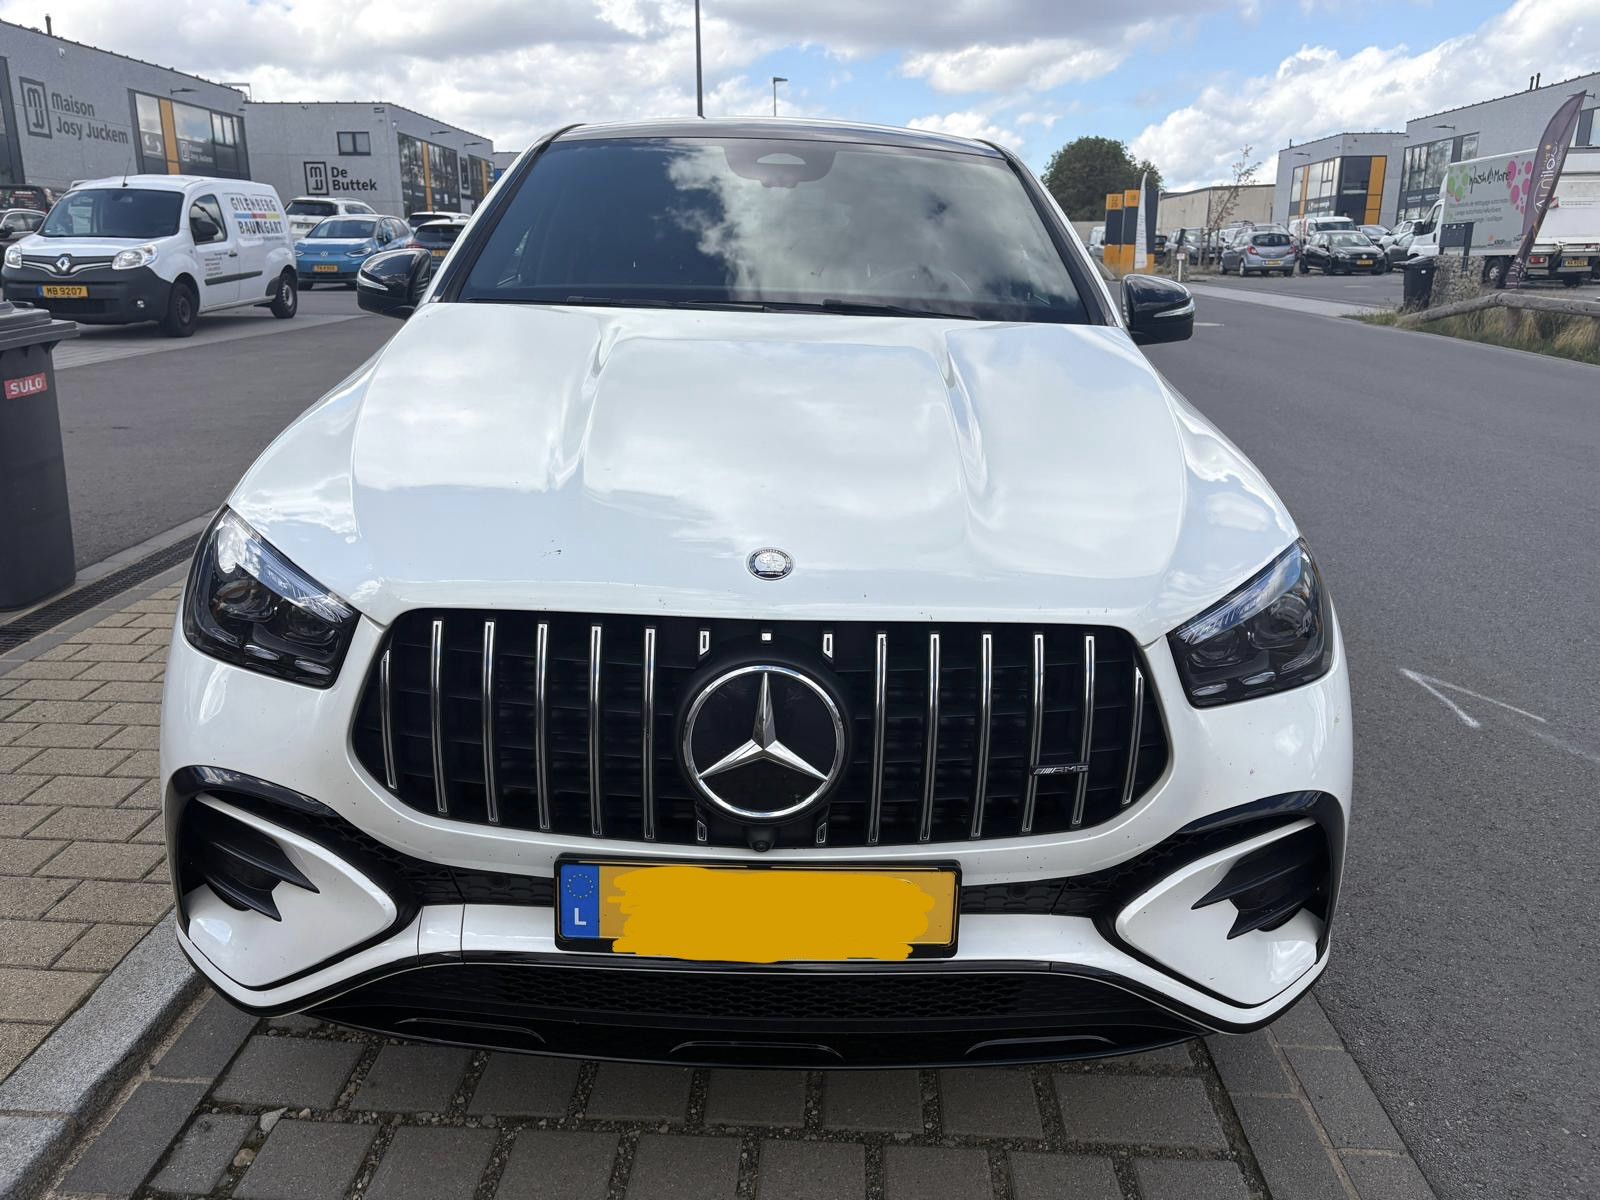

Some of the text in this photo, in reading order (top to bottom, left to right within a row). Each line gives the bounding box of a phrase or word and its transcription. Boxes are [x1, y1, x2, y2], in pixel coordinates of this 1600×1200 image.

[51, 91, 95, 117] Maison
[56, 116, 128, 144] Josy Juckem
[331, 166, 348, 178] De
[332, 178, 377, 191] Buttek
[60, 287, 82, 295] 9207
[574, 907, 587, 926] L
